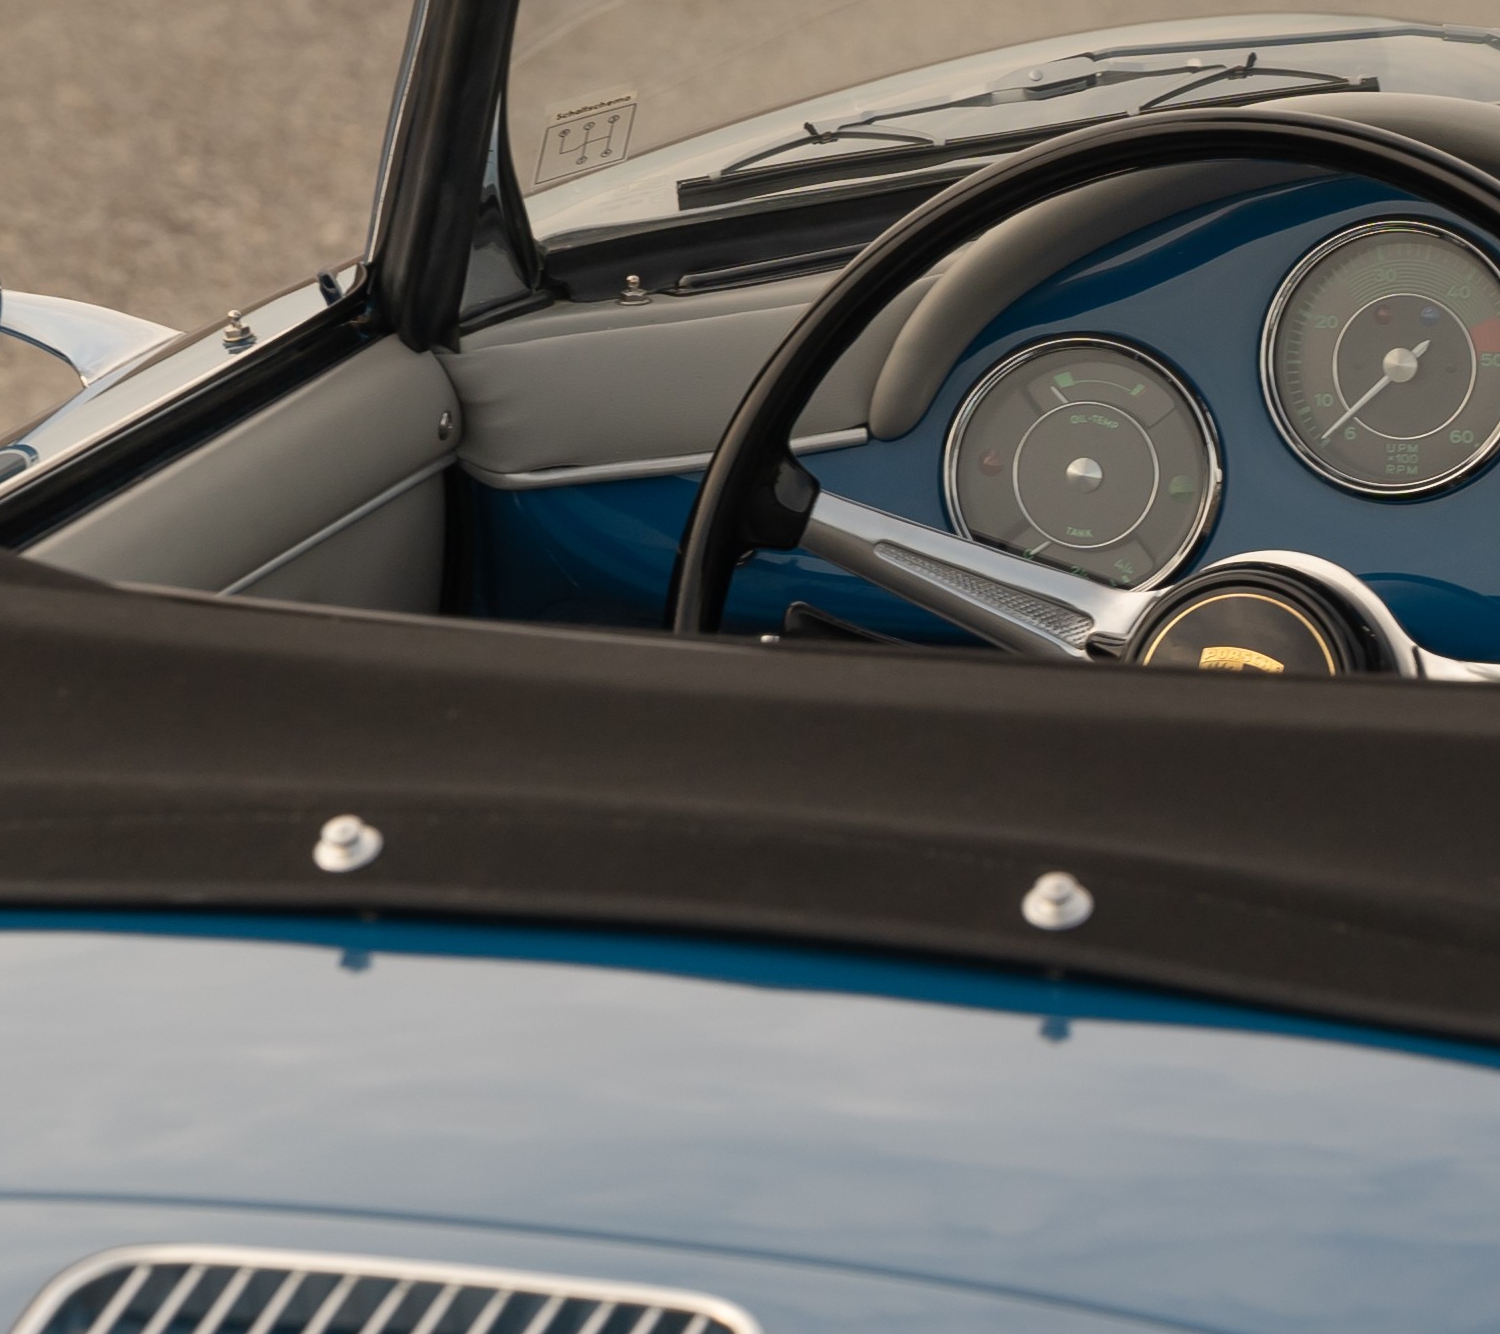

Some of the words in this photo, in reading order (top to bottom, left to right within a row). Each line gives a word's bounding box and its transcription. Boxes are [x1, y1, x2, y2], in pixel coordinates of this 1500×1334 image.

[1374, 269, 1397, 282] 30
[1448, 285, 1472, 299] 40
[1314, 316, 1338, 329] 20
[1314, 393, 1334, 407] 10
[1343, 427, 1357, 440] 6
[1450, 430, 1474, 444] 60
[1385, 443, 1419, 454] UPM
[1385, 465, 1419, 476] RPM
[1065, 526, 1094, 539] TANK
